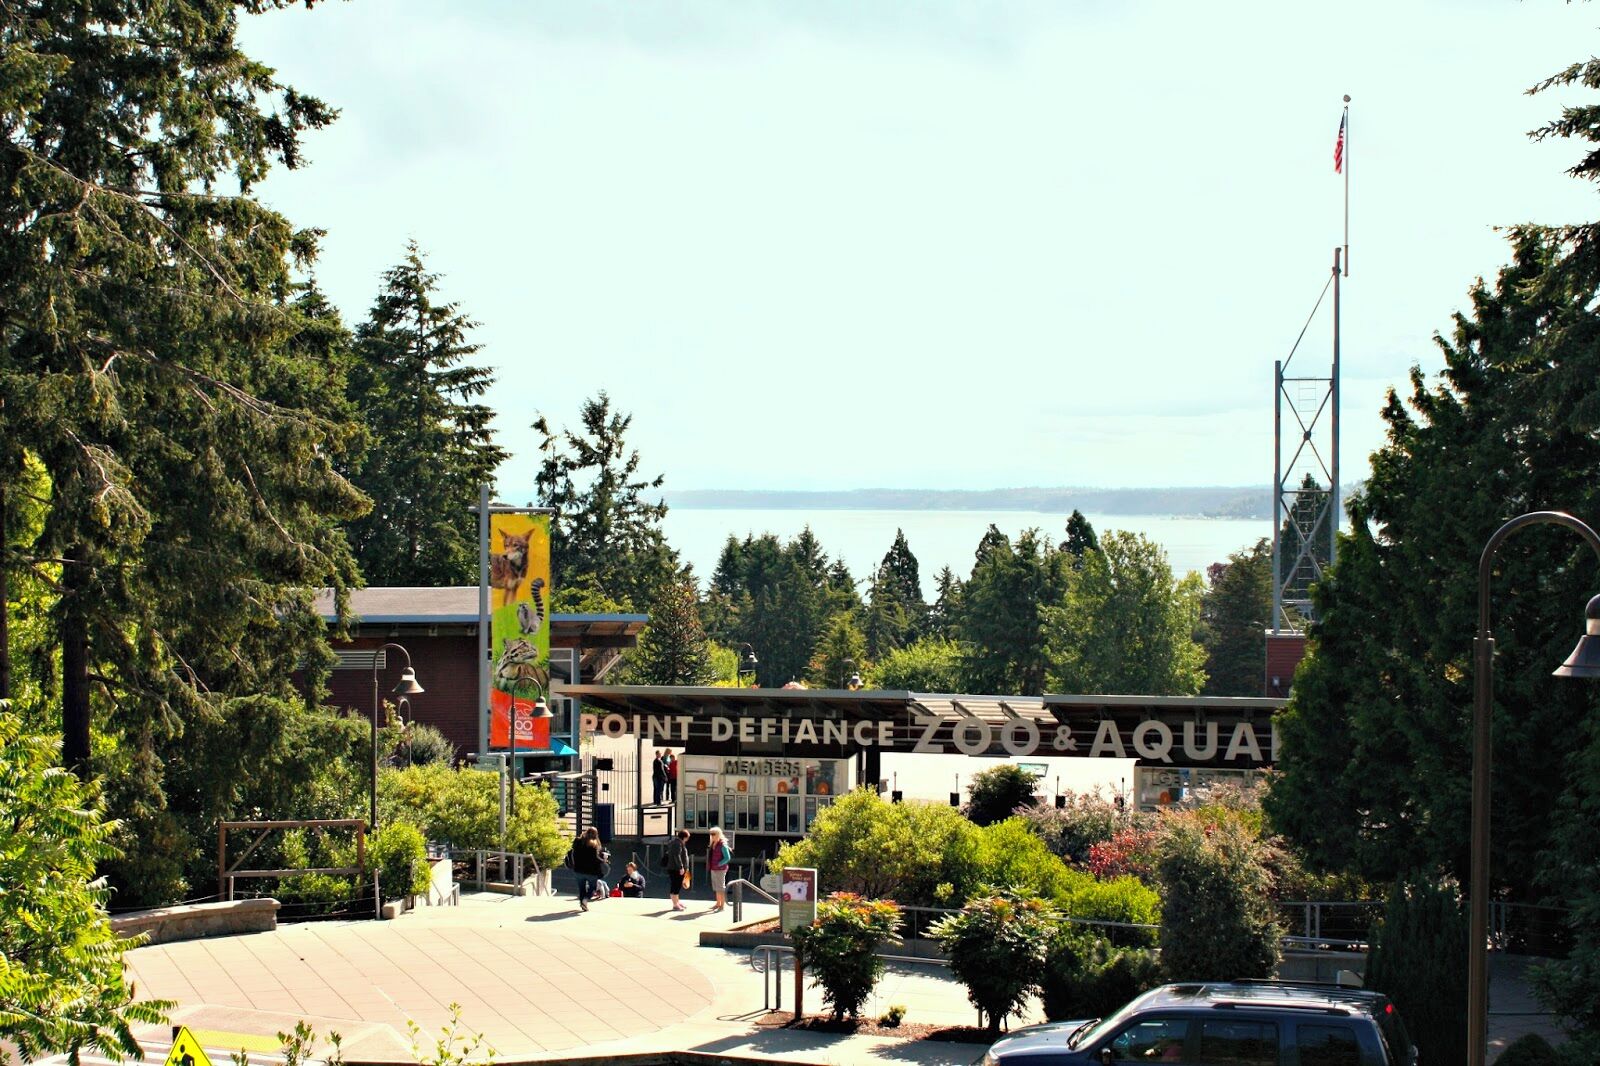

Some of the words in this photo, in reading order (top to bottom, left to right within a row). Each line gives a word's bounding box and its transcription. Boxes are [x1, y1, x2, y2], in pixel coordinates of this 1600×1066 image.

[580, 713, 694, 741] POINT
[711, 716, 894, 746] DEFIANCE
[912, 715, 1041, 756] ZOO
[1053, 724, 1078, 751] &
[724, 759, 802, 777] MEMBERS
